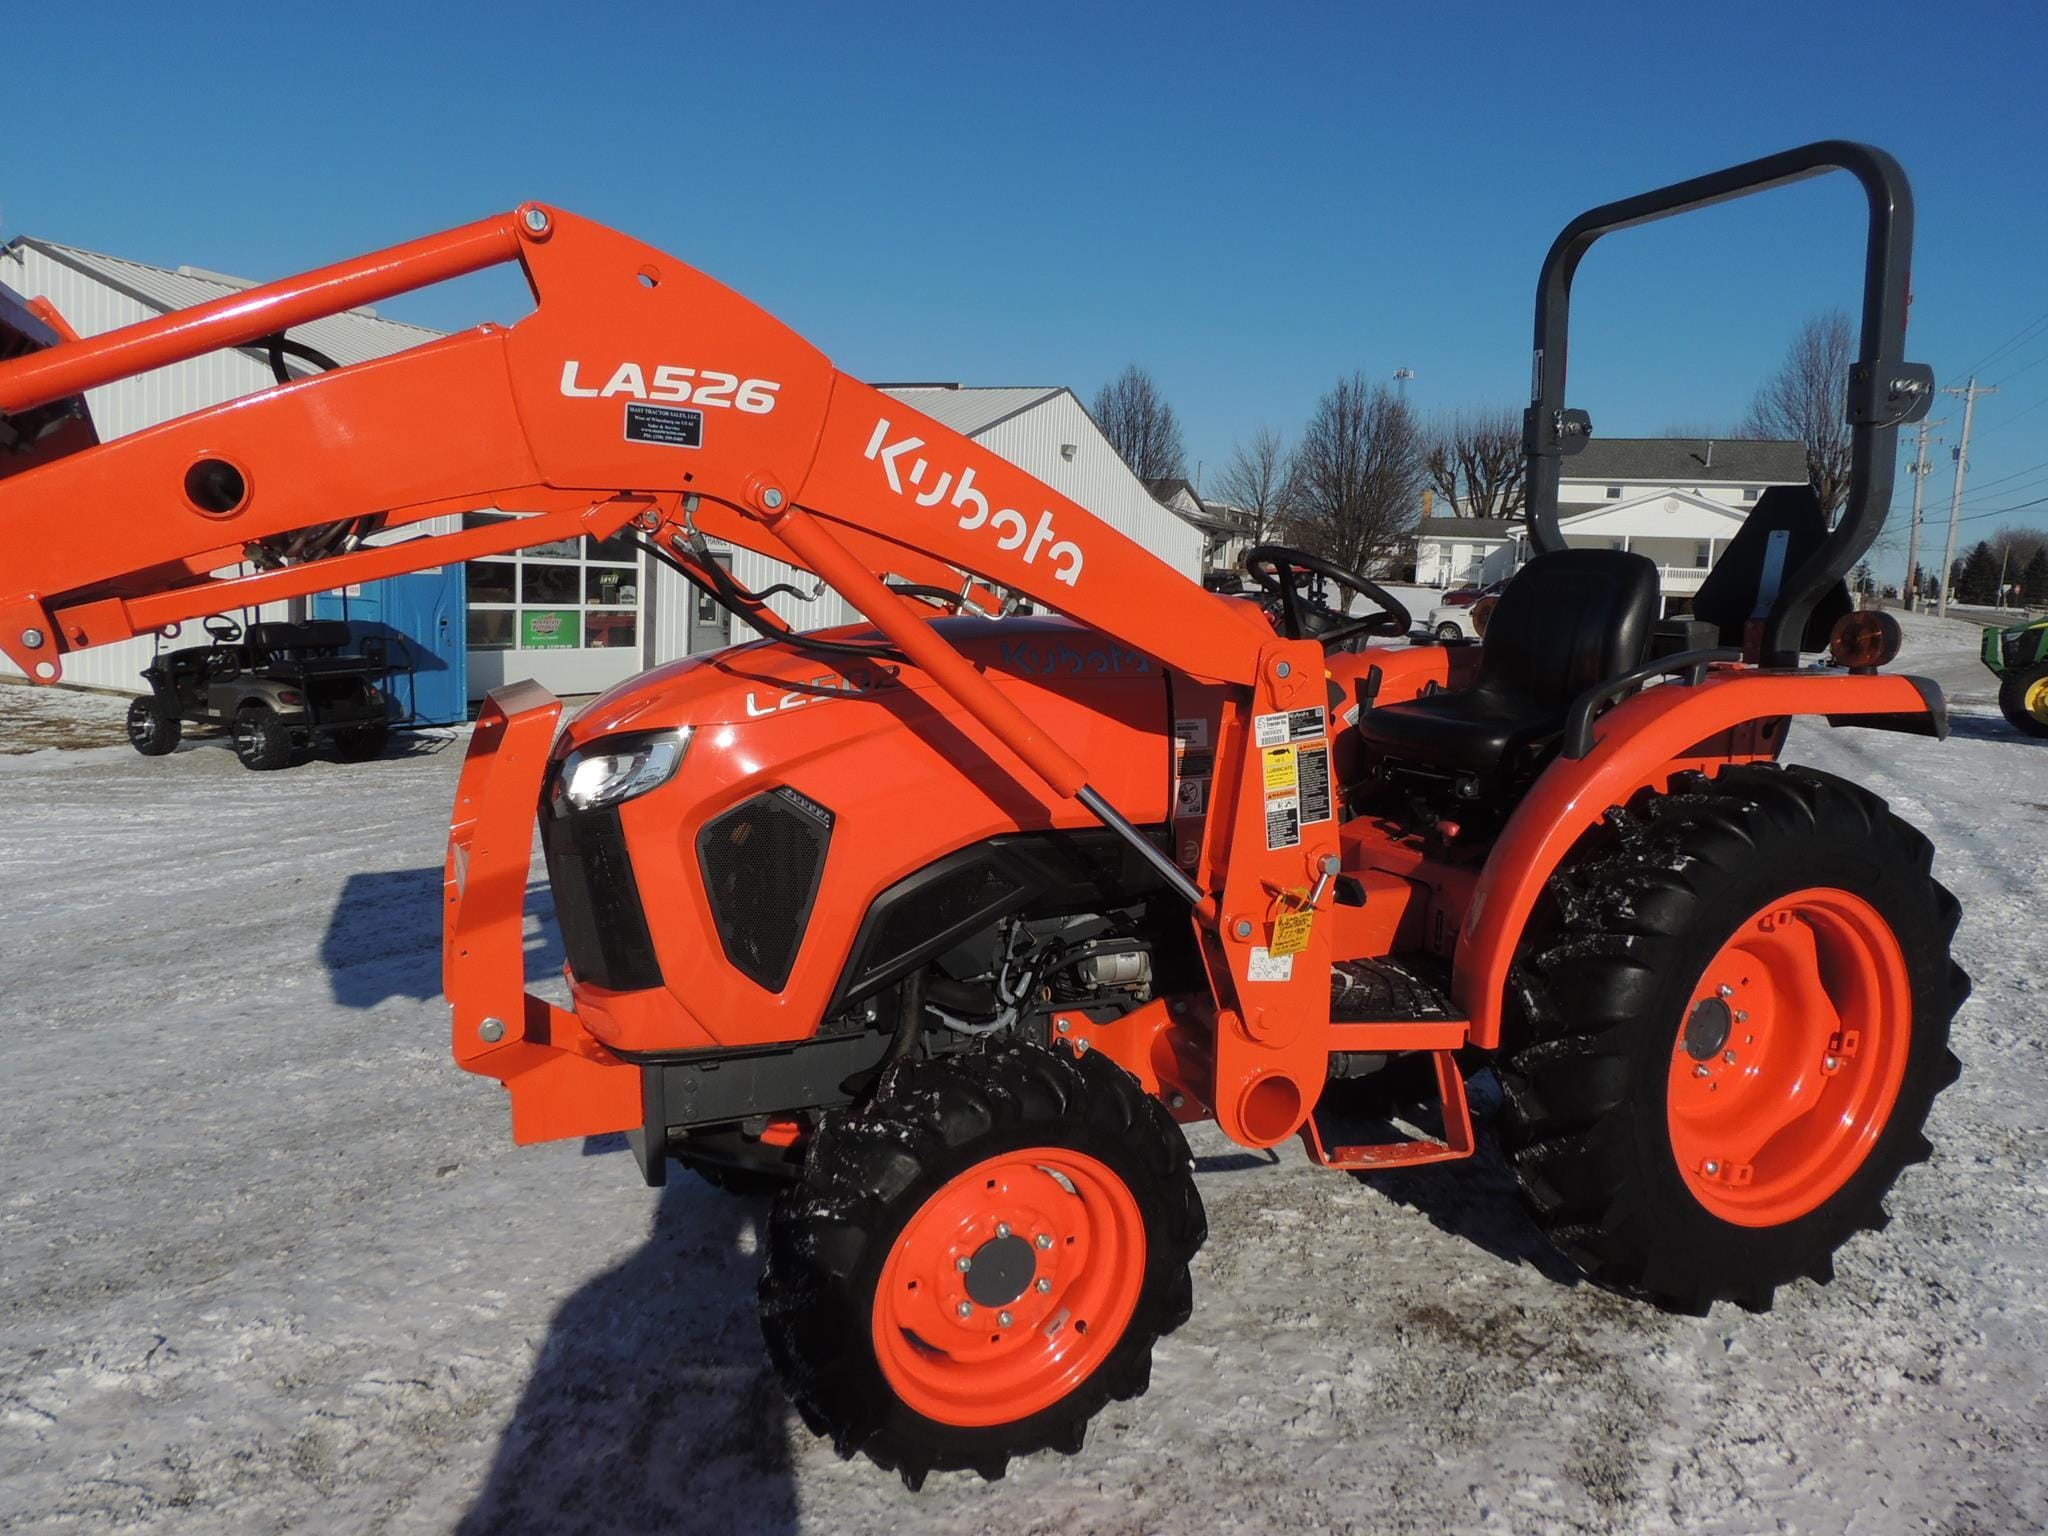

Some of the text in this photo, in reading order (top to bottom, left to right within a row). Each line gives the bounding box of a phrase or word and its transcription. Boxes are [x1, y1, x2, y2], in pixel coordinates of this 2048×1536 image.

[560, 360, 781, 415] LA526
[645, 408, 669, 416] TRACTOR
[863, 417, 1084, 587] Kubota
[1002, 640, 1150, 673] Kubota
